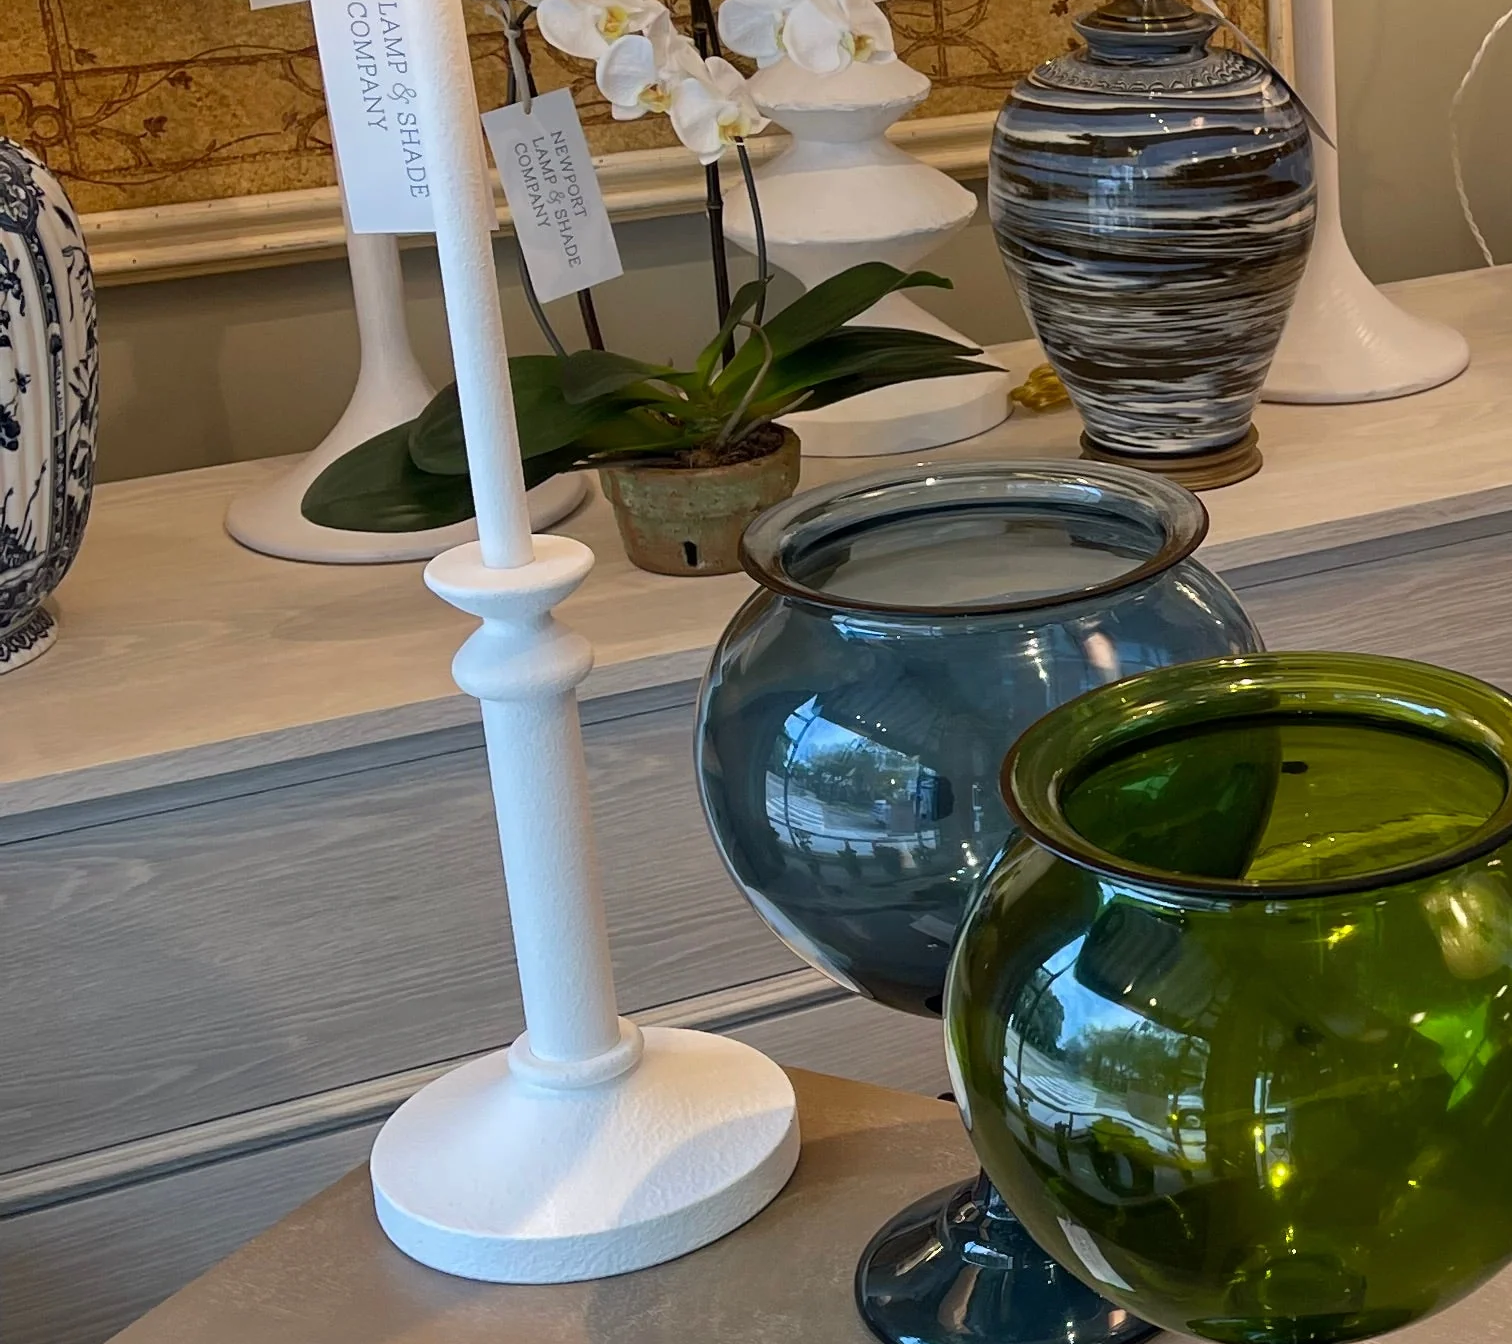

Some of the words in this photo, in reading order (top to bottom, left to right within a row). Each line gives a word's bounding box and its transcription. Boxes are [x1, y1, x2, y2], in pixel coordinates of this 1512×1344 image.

[347, 1, 389, 132] COMPANY
[377, 2, 408, 75] LAMP
[386, 82, 417, 105] &
[397, 112, 430, 198] SHADE
[514, 142, 551, 227] COMPANY
[532, 136, 558, 185] LAMP
[550, 130, 588, 217] NEWPORT
[546, 190, 566, 205] &
[554, 208, 582, 268] SHADE
